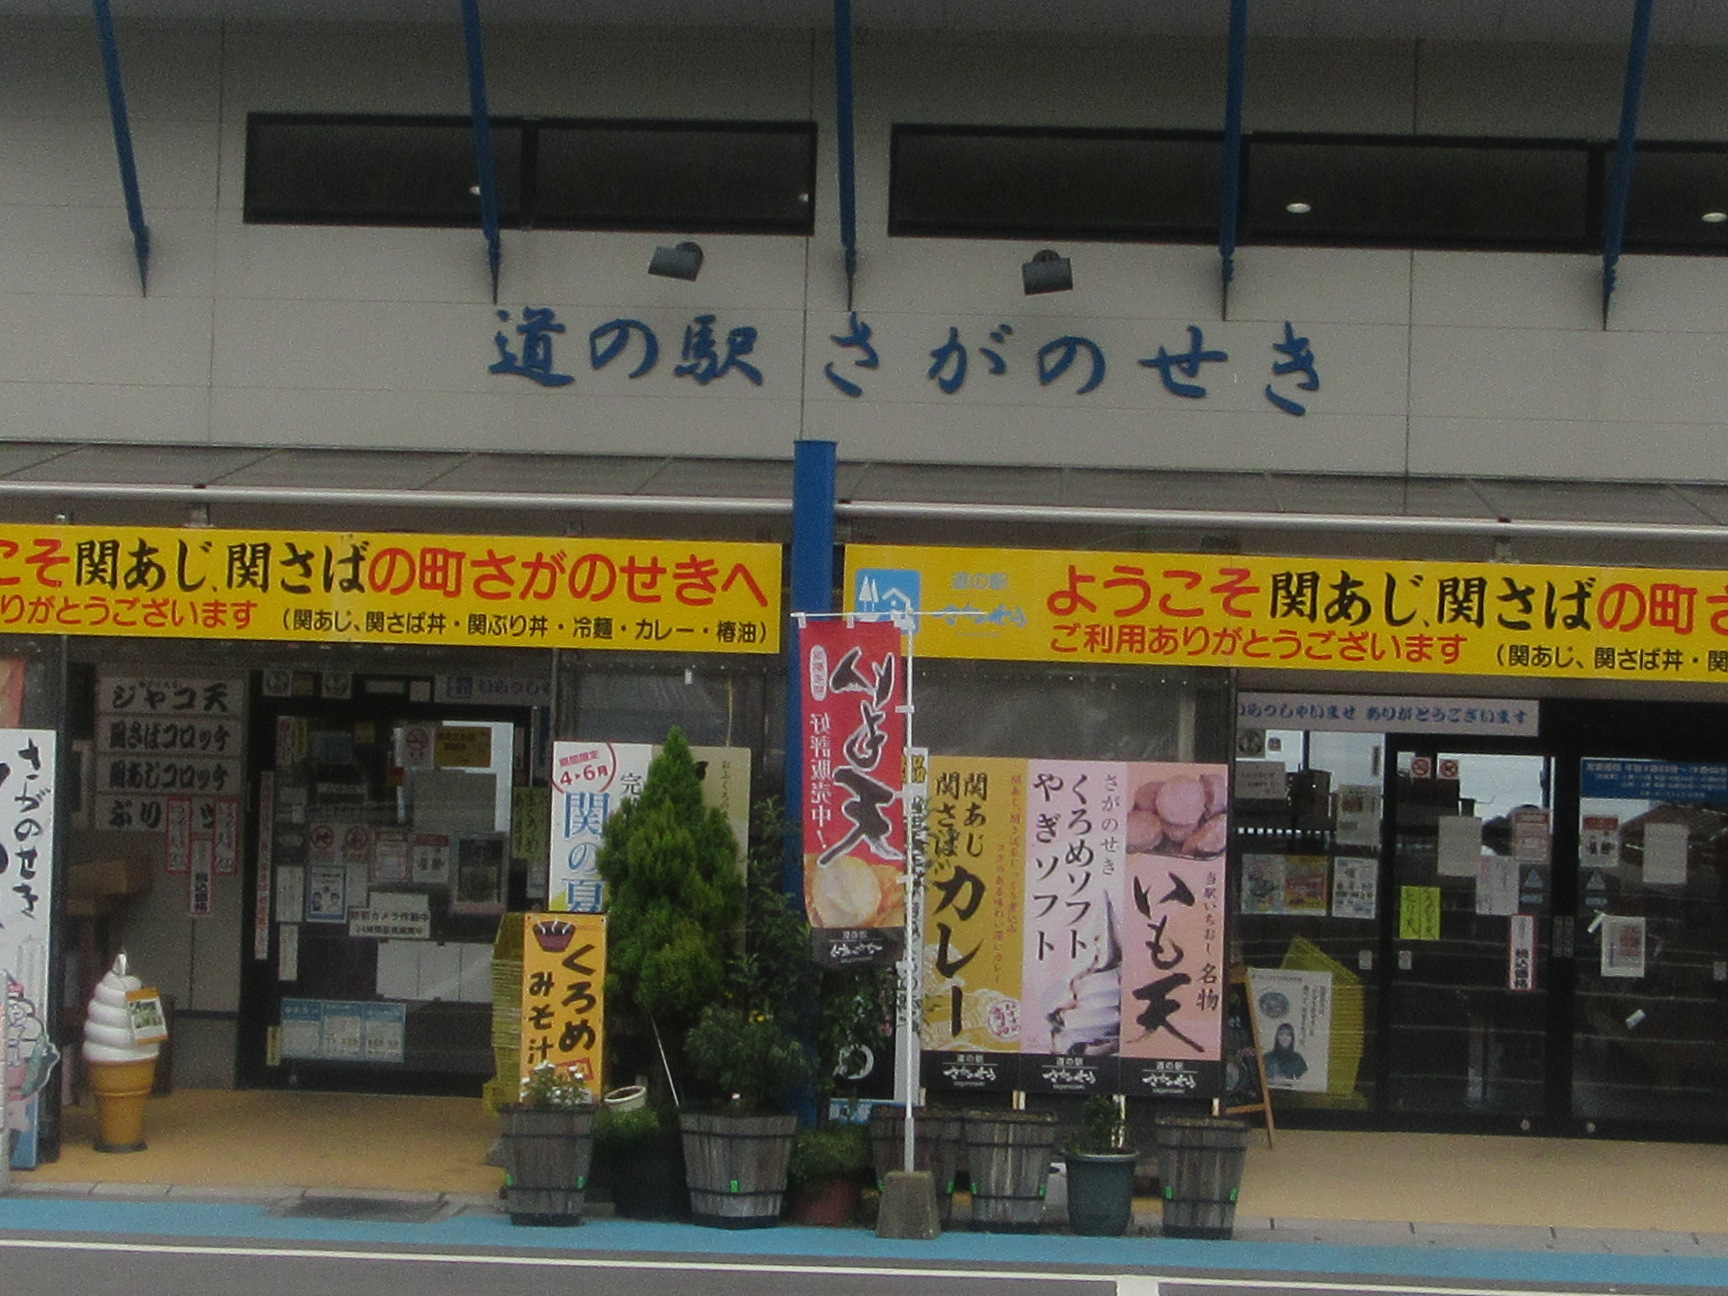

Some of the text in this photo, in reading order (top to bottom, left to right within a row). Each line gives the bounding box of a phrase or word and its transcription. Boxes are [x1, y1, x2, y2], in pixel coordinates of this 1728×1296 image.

[488, 307, 1320, 418] 道の駅 さがのせき
[1049, 624, 1468, 664] ご利用ありがとうございます
[108, 719, 231, 752] 関さばコロッケ
[112, 682, 229, 713] ジャコ天
[1366, 706, 1527, 724] ありがとうございます
[108, 758, 230, 792] 関あじコロッケ
[559, 749, 600, 767] 期間限定
[11, 736, 51, 920] さがのせき
[934, 771, 961, 857] 関さば
[963, 771, 989, 858] 関あじ
[1099, 773, 1121, 876] さがのせき
[1032, 772, 1063, 962] やぎソフト
[1064, 773, 1094, 953] くろめソフト
[931, 864, 987, 1038] カレー
[1126, 871, 1206, 1054] いも天
[1195, 961, 1220, 1013] 名物
[526, 970, 555, 1066] みそ汁
[558, 943, 597, 1052] くろめ
